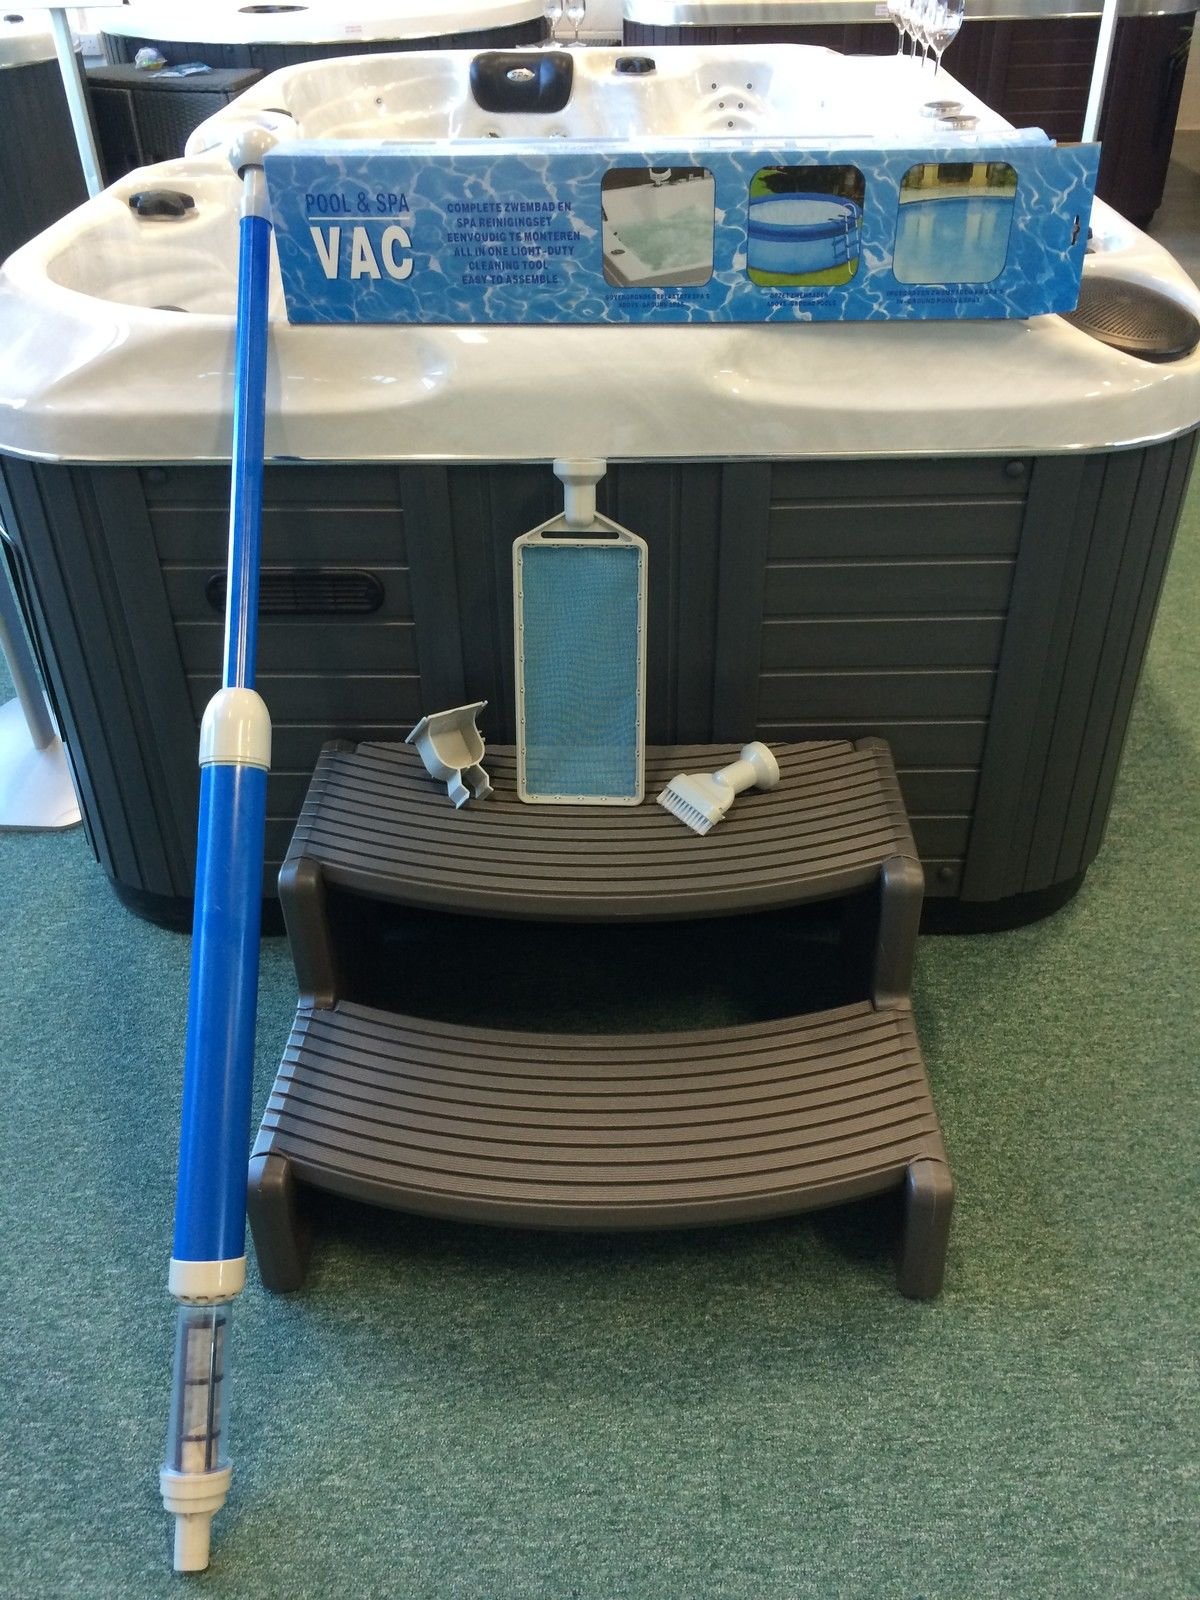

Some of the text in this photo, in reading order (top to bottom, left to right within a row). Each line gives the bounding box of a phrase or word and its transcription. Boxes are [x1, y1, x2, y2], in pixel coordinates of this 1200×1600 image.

[305, 192, 409, 213] POOL & SPA
[447, 201, 571, 213] COMPLETE ZWEMBAD EN
[457, 217, 552, 228] SPA REINIGINGSET
[447, 231, 580, 242] EENVOUDIG TE MONTEREN
[310, 225, 414, 280] VAC
[454, 247, 473, 257] ALL
[475, 247, 486, 256] IN
[488, 247, 508, 256] ONE
[468, 261, 548, 271] CLEANING TOOL
[462, 274, 558, 284] EASY TO ASSEMBLE
